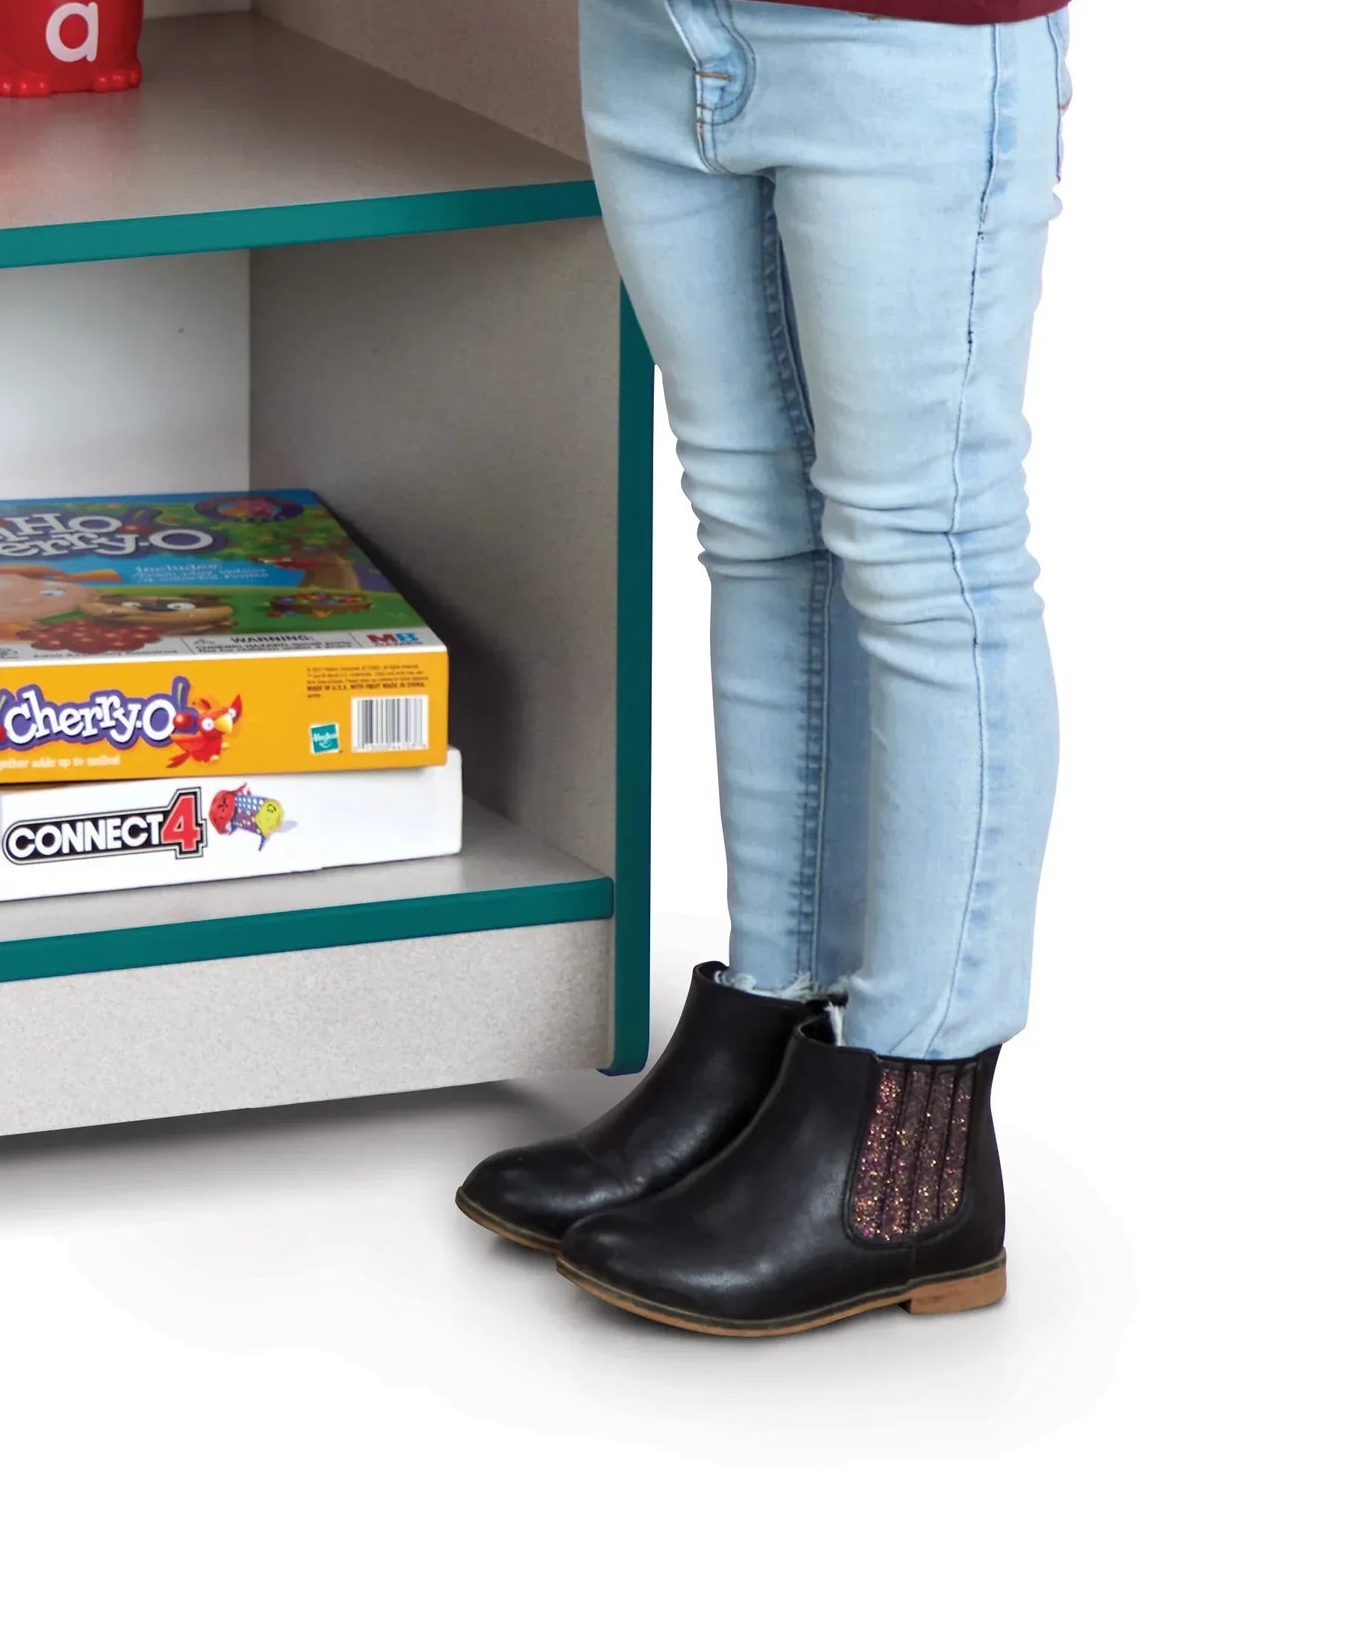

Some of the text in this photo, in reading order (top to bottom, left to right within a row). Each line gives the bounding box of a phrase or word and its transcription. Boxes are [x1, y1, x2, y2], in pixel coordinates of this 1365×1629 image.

[45, 2, 97, 61] a
[32, 757, 56, 768] adds
[58, 758, 71, 769] up
[73, 757, 85, 766] to
[8, 794, 200, 858] CONNECT 4
